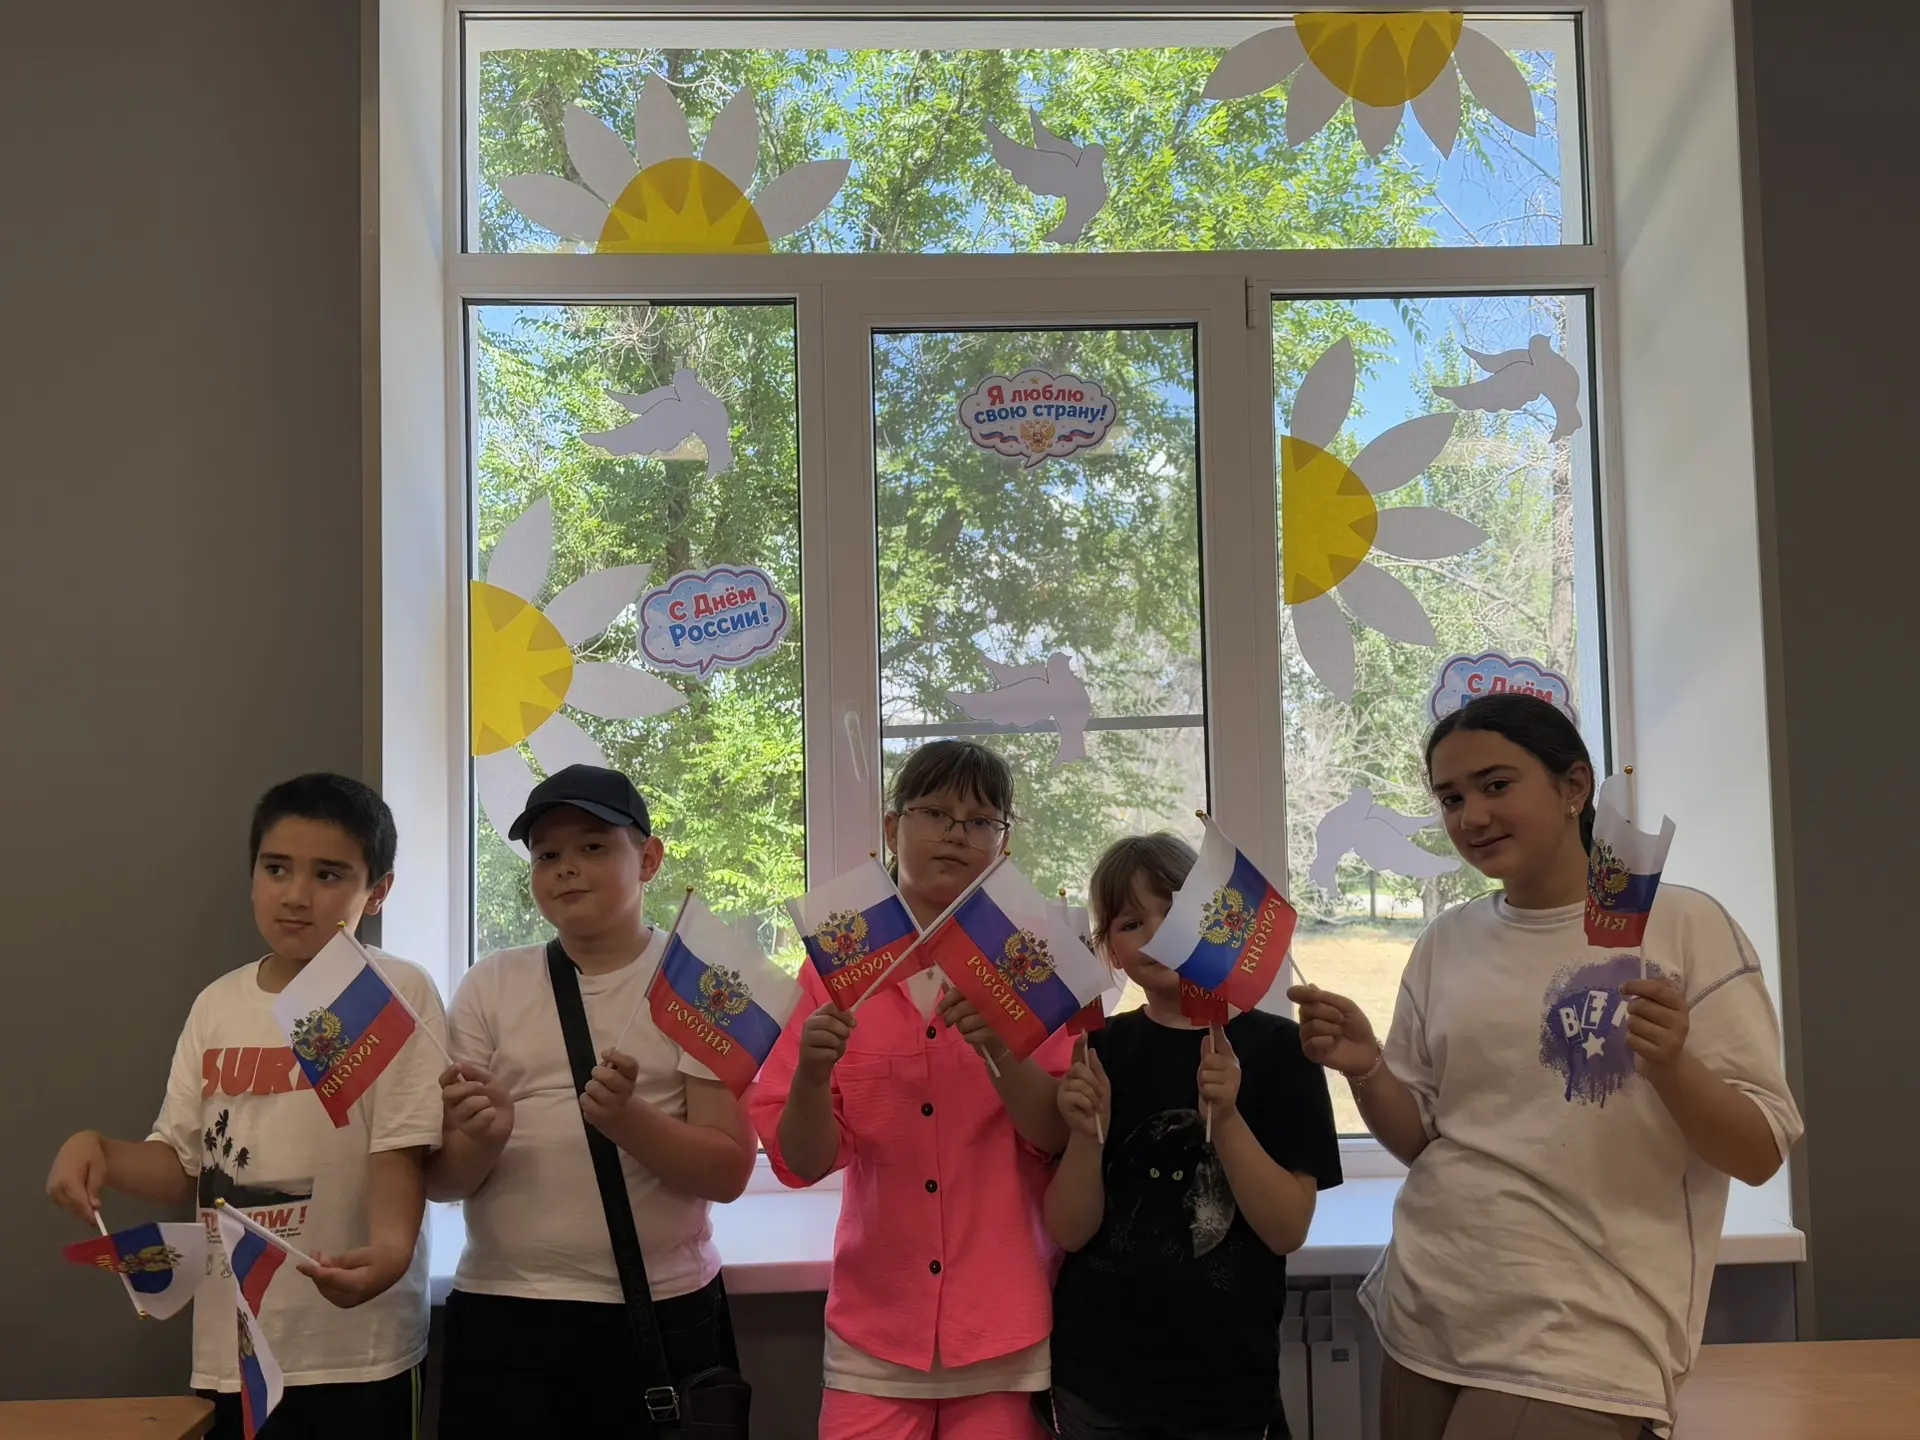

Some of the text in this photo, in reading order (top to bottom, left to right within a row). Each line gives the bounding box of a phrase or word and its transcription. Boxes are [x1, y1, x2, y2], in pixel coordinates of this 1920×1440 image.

[987, 384, 1084, 407] Я люблю
[974, 404, 1108, 424] свою страну!
[669, 586, 757, 621] С Днём
[669, 602, 770, 647] России!
[1467, 673, 1484, 694] С
[967, 956, 1028, 1022] РОССИЯ
[667, 1001, 733, 1057] РОССИЯ
